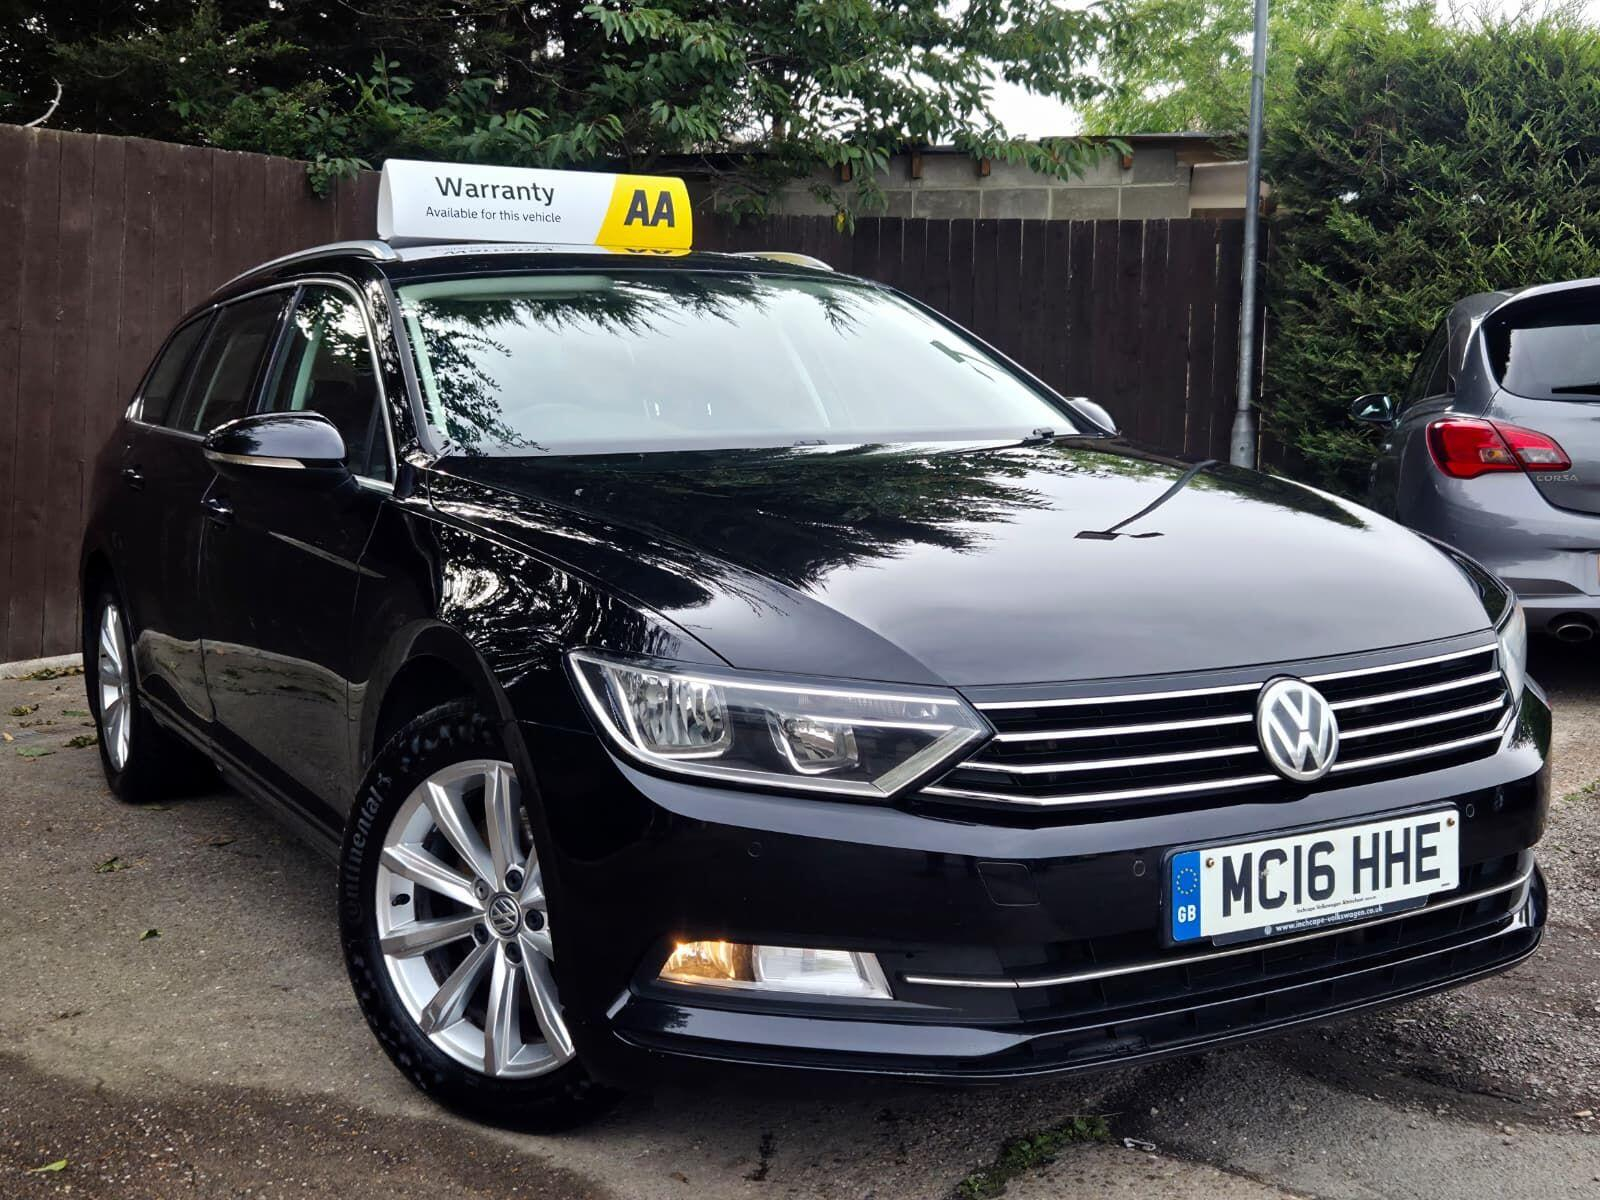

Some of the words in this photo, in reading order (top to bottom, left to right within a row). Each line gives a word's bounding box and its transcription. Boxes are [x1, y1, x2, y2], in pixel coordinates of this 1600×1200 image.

[434, 176, 554, 206] Warranty
[425, 206, 478, 219] Available
[481, 209, 497, 220] for
[499, 210, 520, 221] this
[522, 211, 562, 223] vehicle
[624, 189, 675, 228] AA
[1536, 474, 1578, 482] CORSA
[1259, 677, 1338, 781] VW
[1222, 840, 1336, 917] MC16
[1352, 821, 1441, 894] HHE
[1177, 904, 1197, 924] GB
